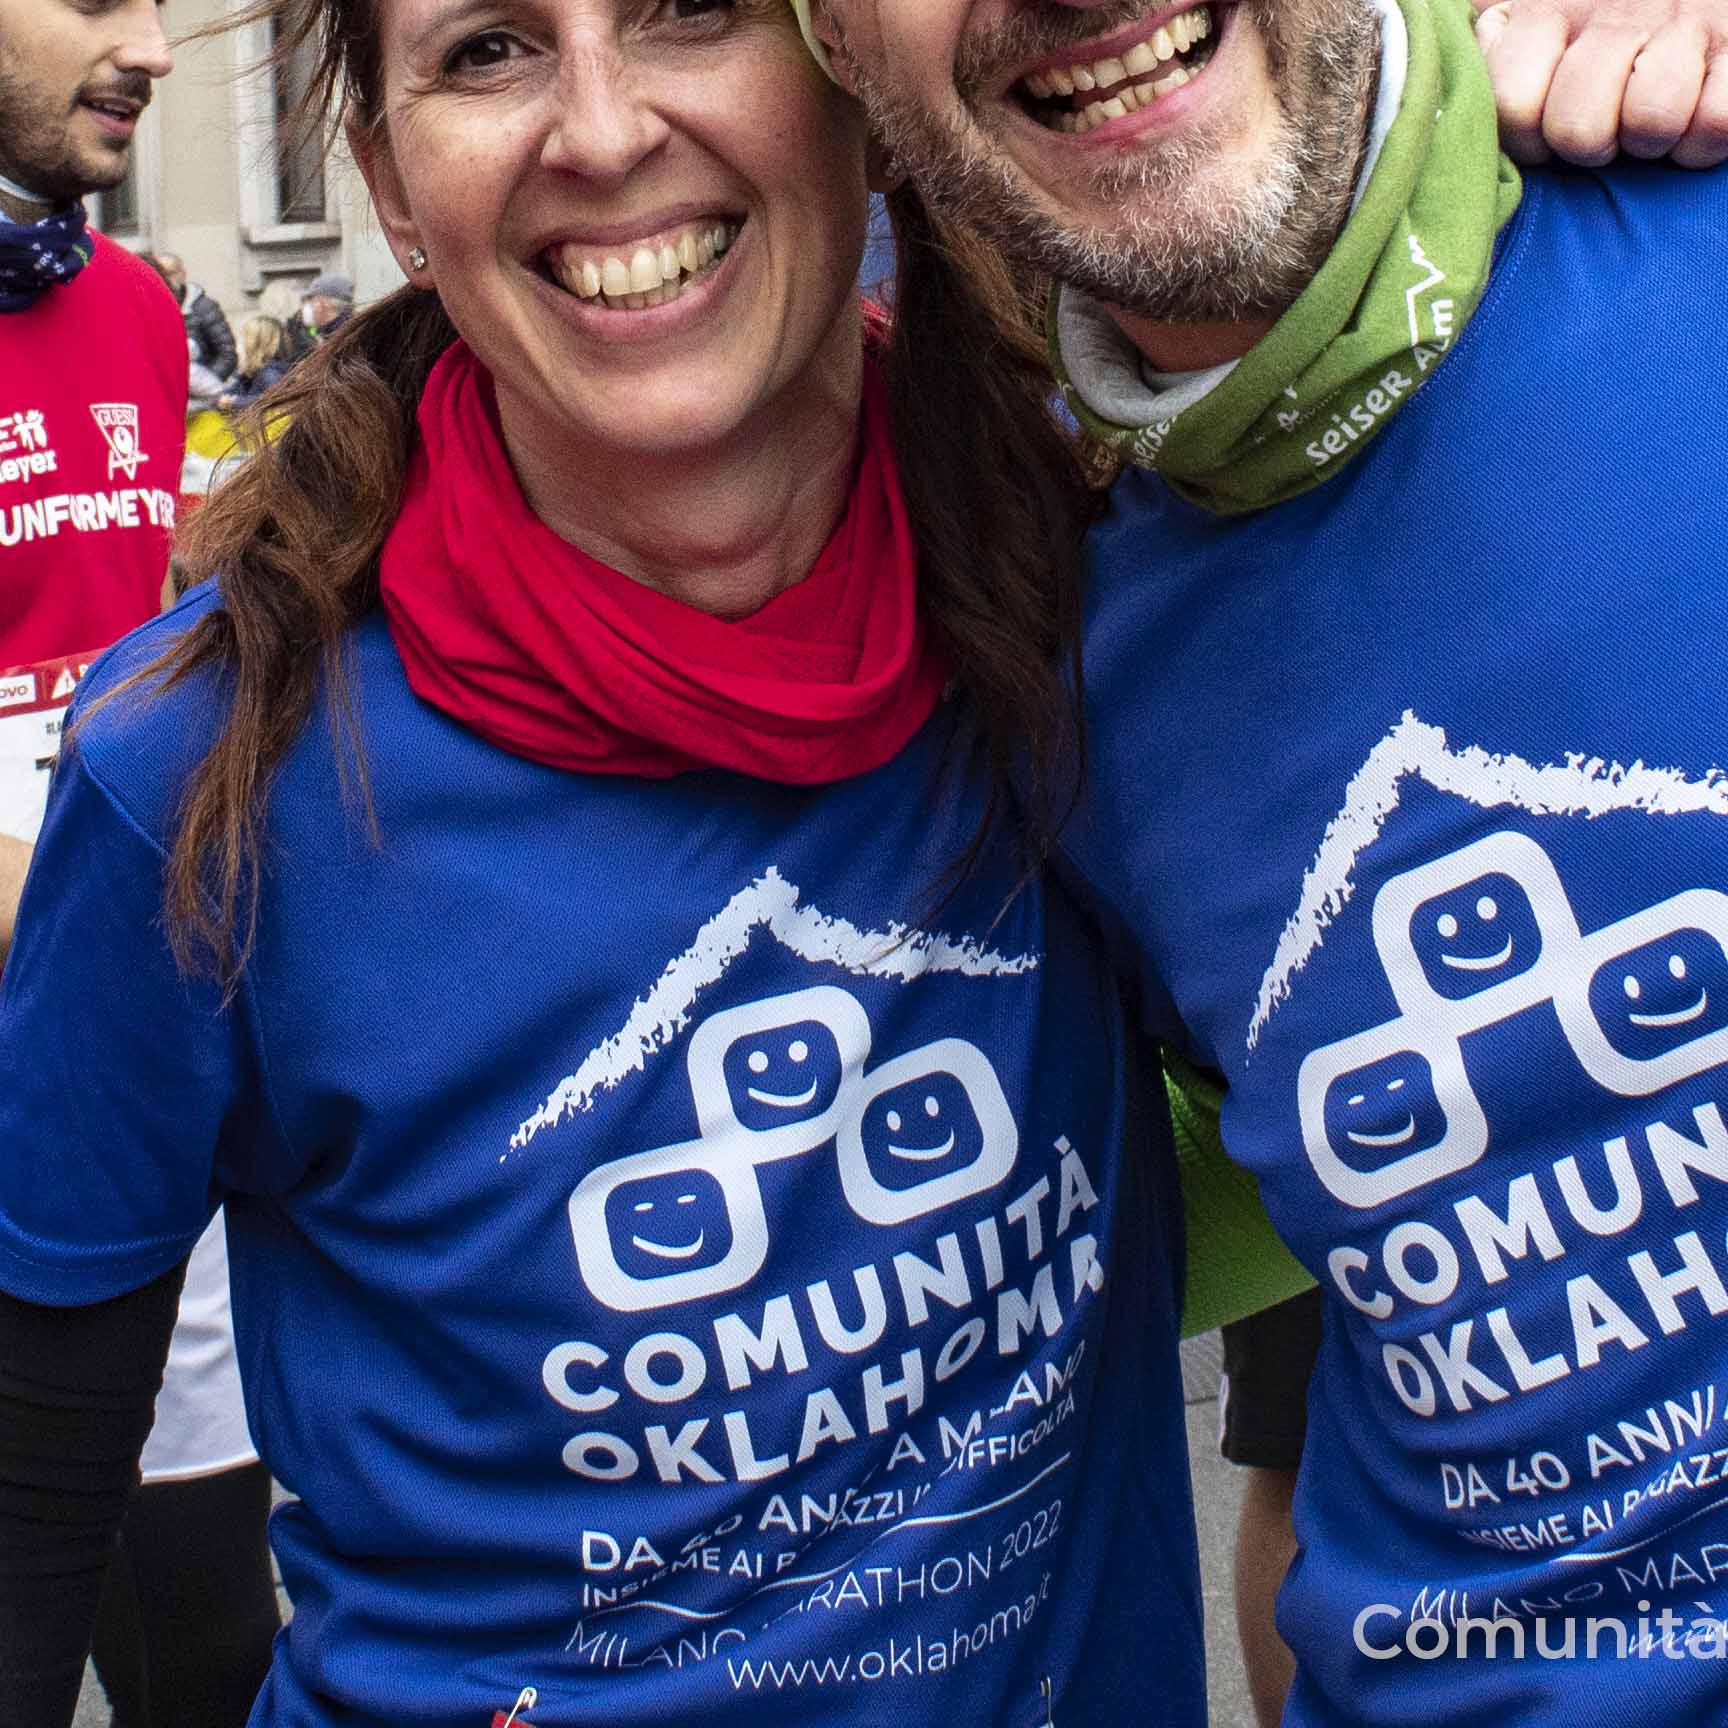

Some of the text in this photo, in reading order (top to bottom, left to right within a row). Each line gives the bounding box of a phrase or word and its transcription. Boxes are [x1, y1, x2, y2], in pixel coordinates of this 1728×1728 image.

[542, 1133, 1101, 1414] COMUNITÀ
[562, 1233, 1105, 1485] OKLAHOMA
[581, 1529, 665, 1572] DA
[886, 1431, 926, 1471] A
[1440, 1460, 1501, 1511] DA
[1506, 1451, 1571, 1497] 40
[999, 1499, 1062, 1572] 2022
[1582, 1499, 1614, 1538] AI
[728, 1549, 763, 1580] AI
